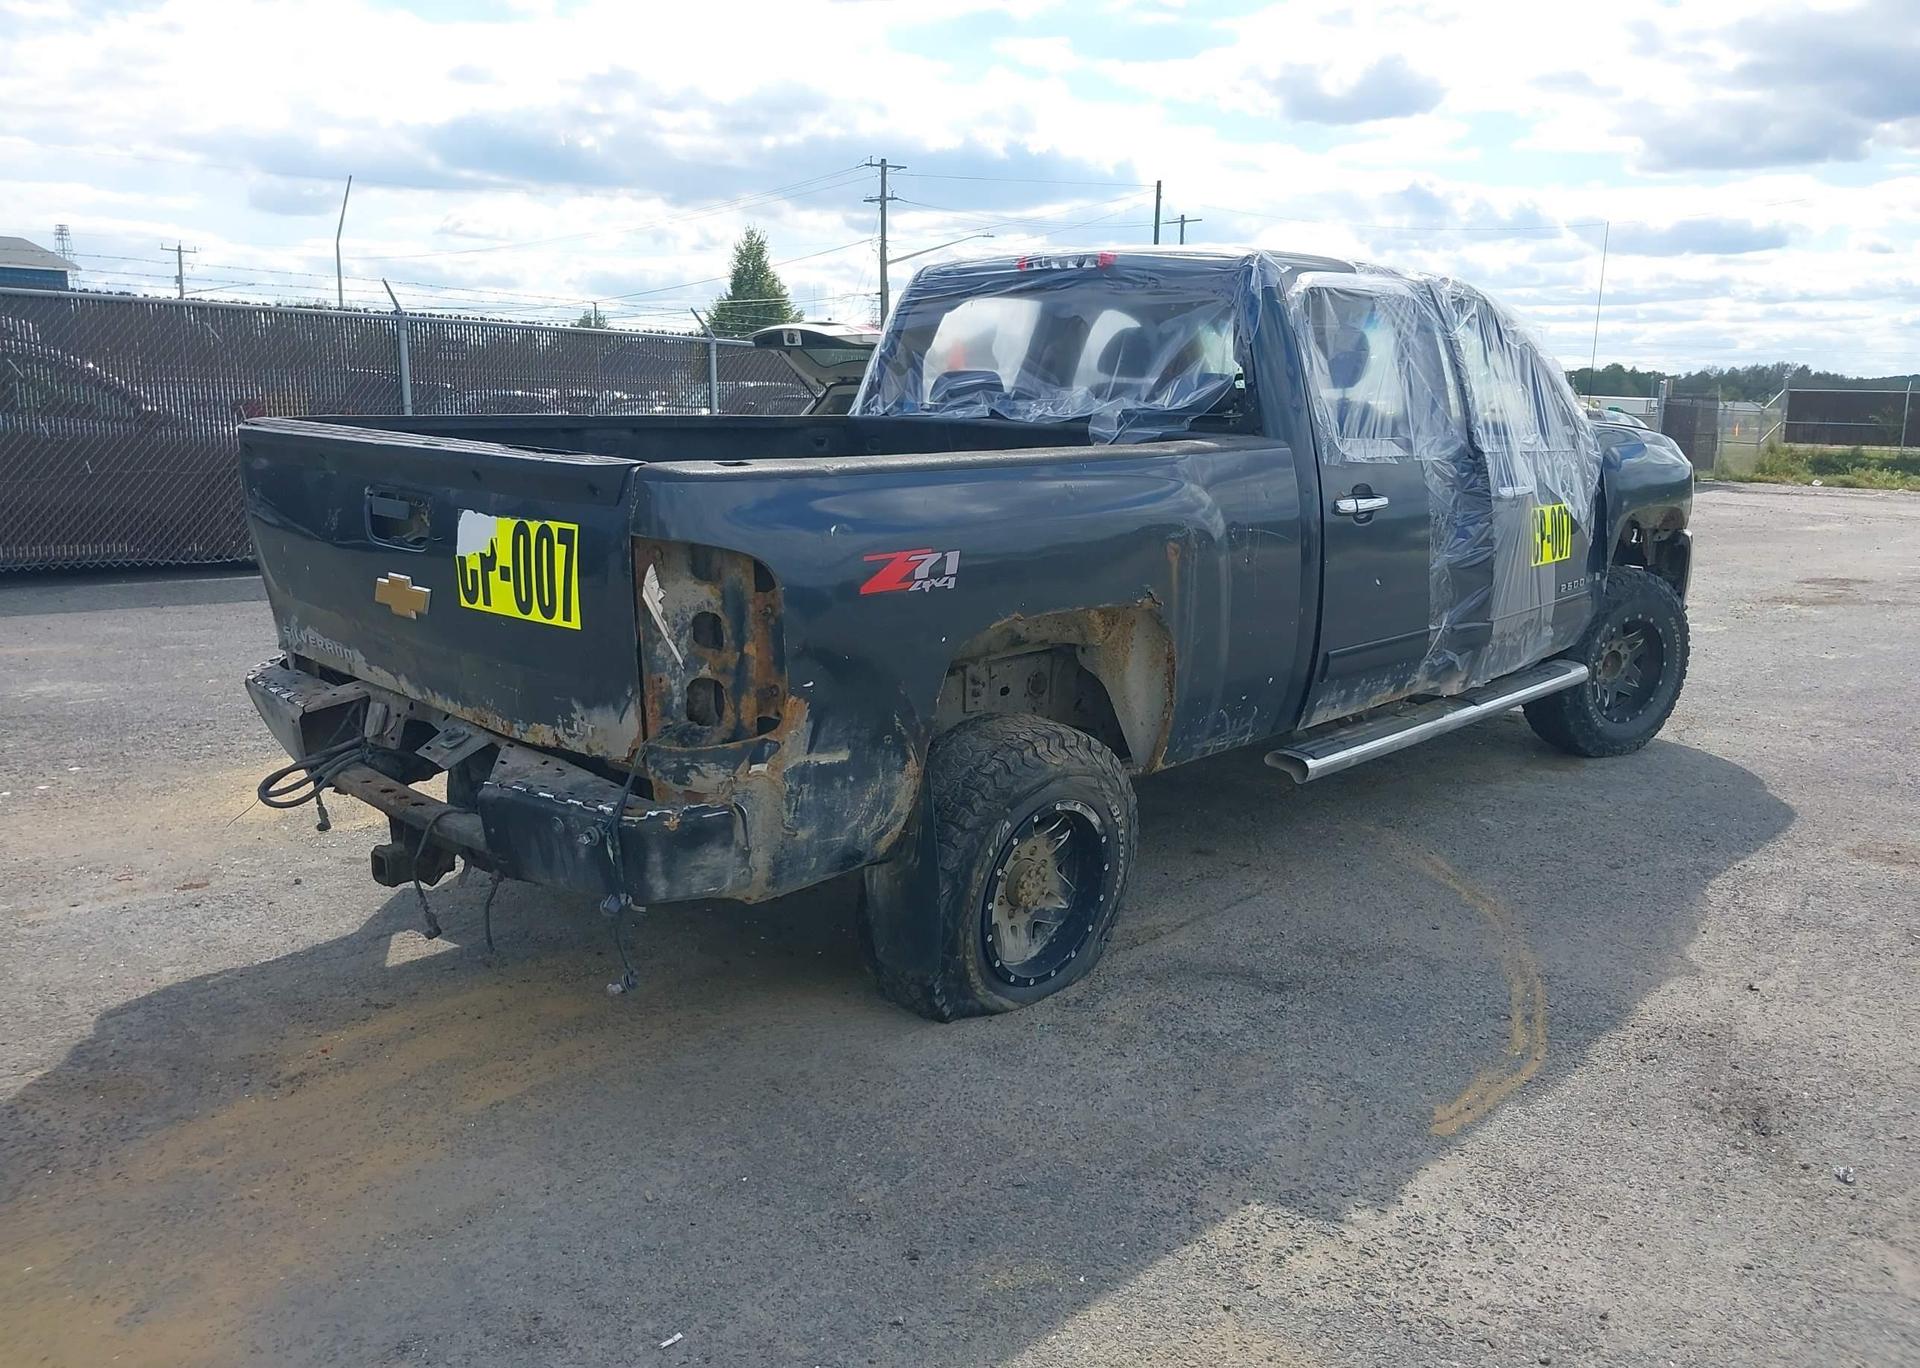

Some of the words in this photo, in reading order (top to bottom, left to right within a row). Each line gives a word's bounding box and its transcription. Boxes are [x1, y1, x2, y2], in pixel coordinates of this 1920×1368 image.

[1532, 505, 1569, 565] CP-007
[860, 548, 961, 595] Z71
[1560, 578, 1585, 593] 2500
